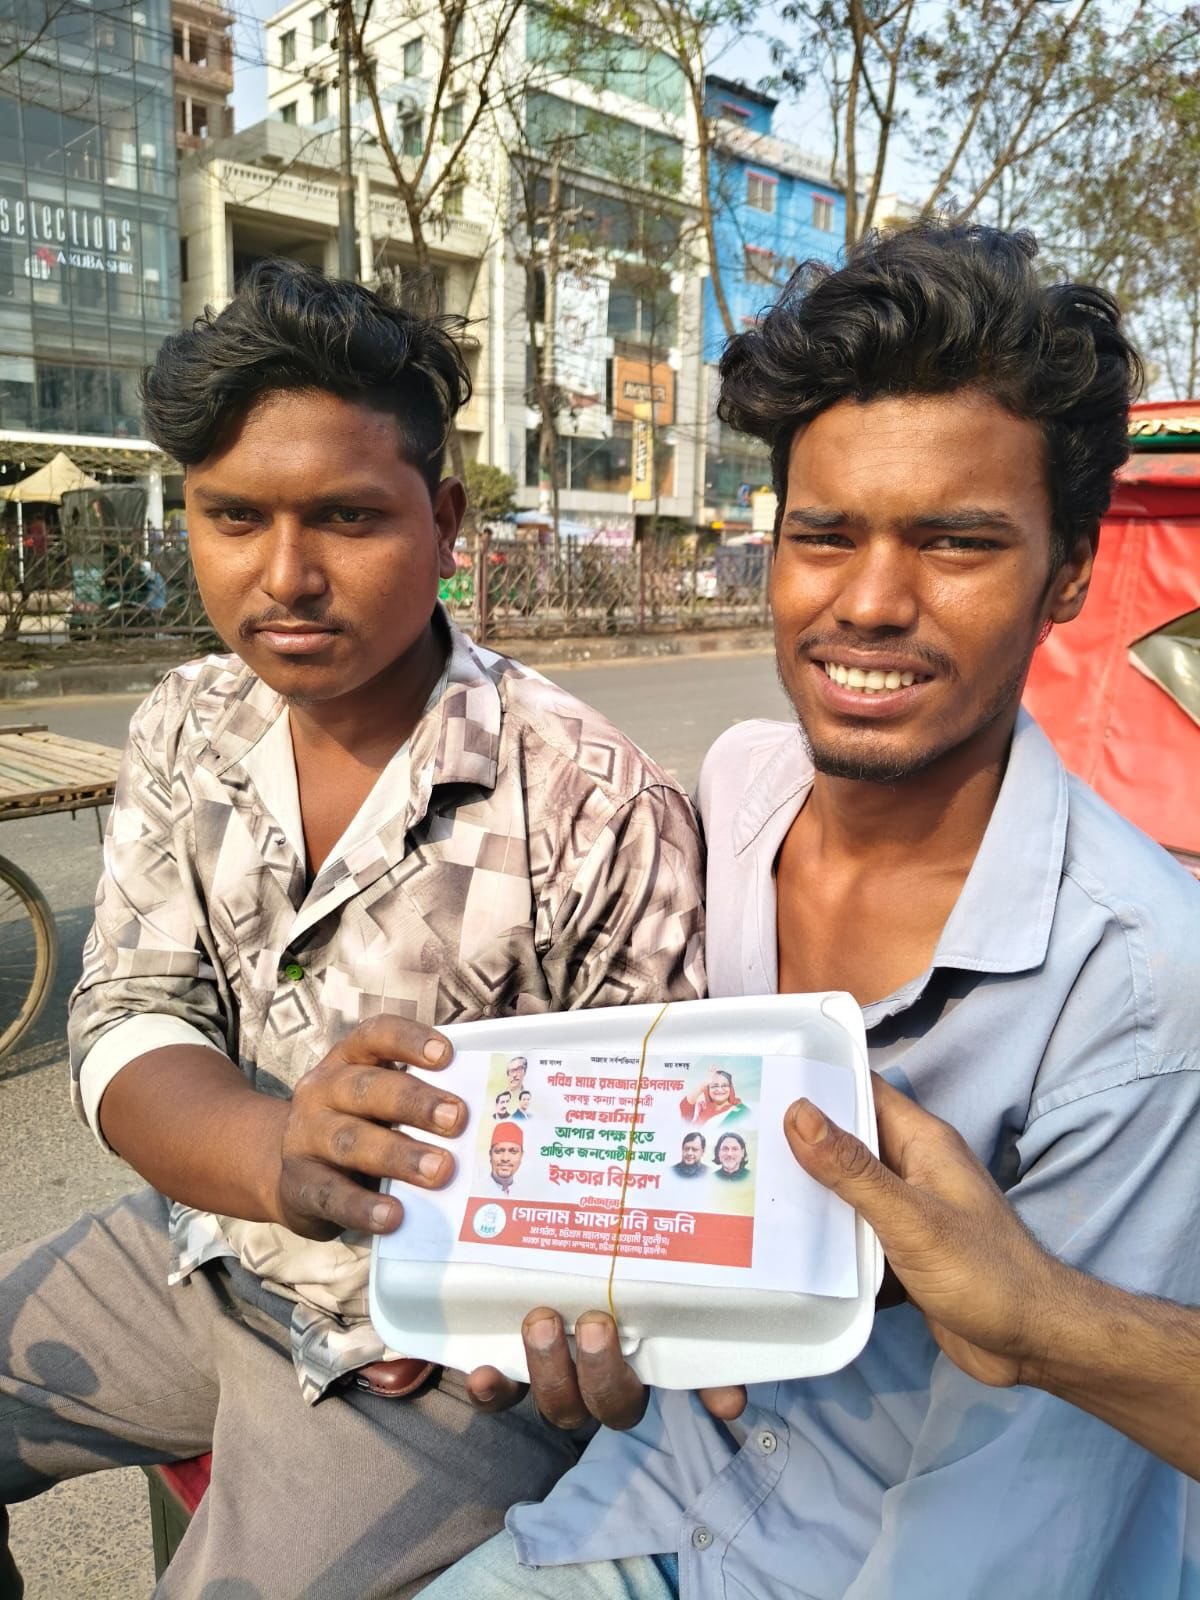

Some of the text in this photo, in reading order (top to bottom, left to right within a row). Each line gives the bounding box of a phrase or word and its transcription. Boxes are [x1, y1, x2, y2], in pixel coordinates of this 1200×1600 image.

[547, 1072, 573, 1087] পবিত্র
[575, 1076, 597, 1089] মাহে
[599, 1077, 638, 1090] রমজান
[593, 1095, 616, 1106] কন্যা
[565, 1108, 646, 1124] শেখ হাসিনা
[554, 1126, 656, 1144] আপার পক্ষ হতে
[540, 1141, 667, 1163] প্রান্তিক জনগোষ্ঠীর মাঝে
[548, 1162, 661, 1189] ইফতার বিতরণ
[511, 1206, 571, 1225] গোলাম
[653, 1212, 697, 1235] জনি
